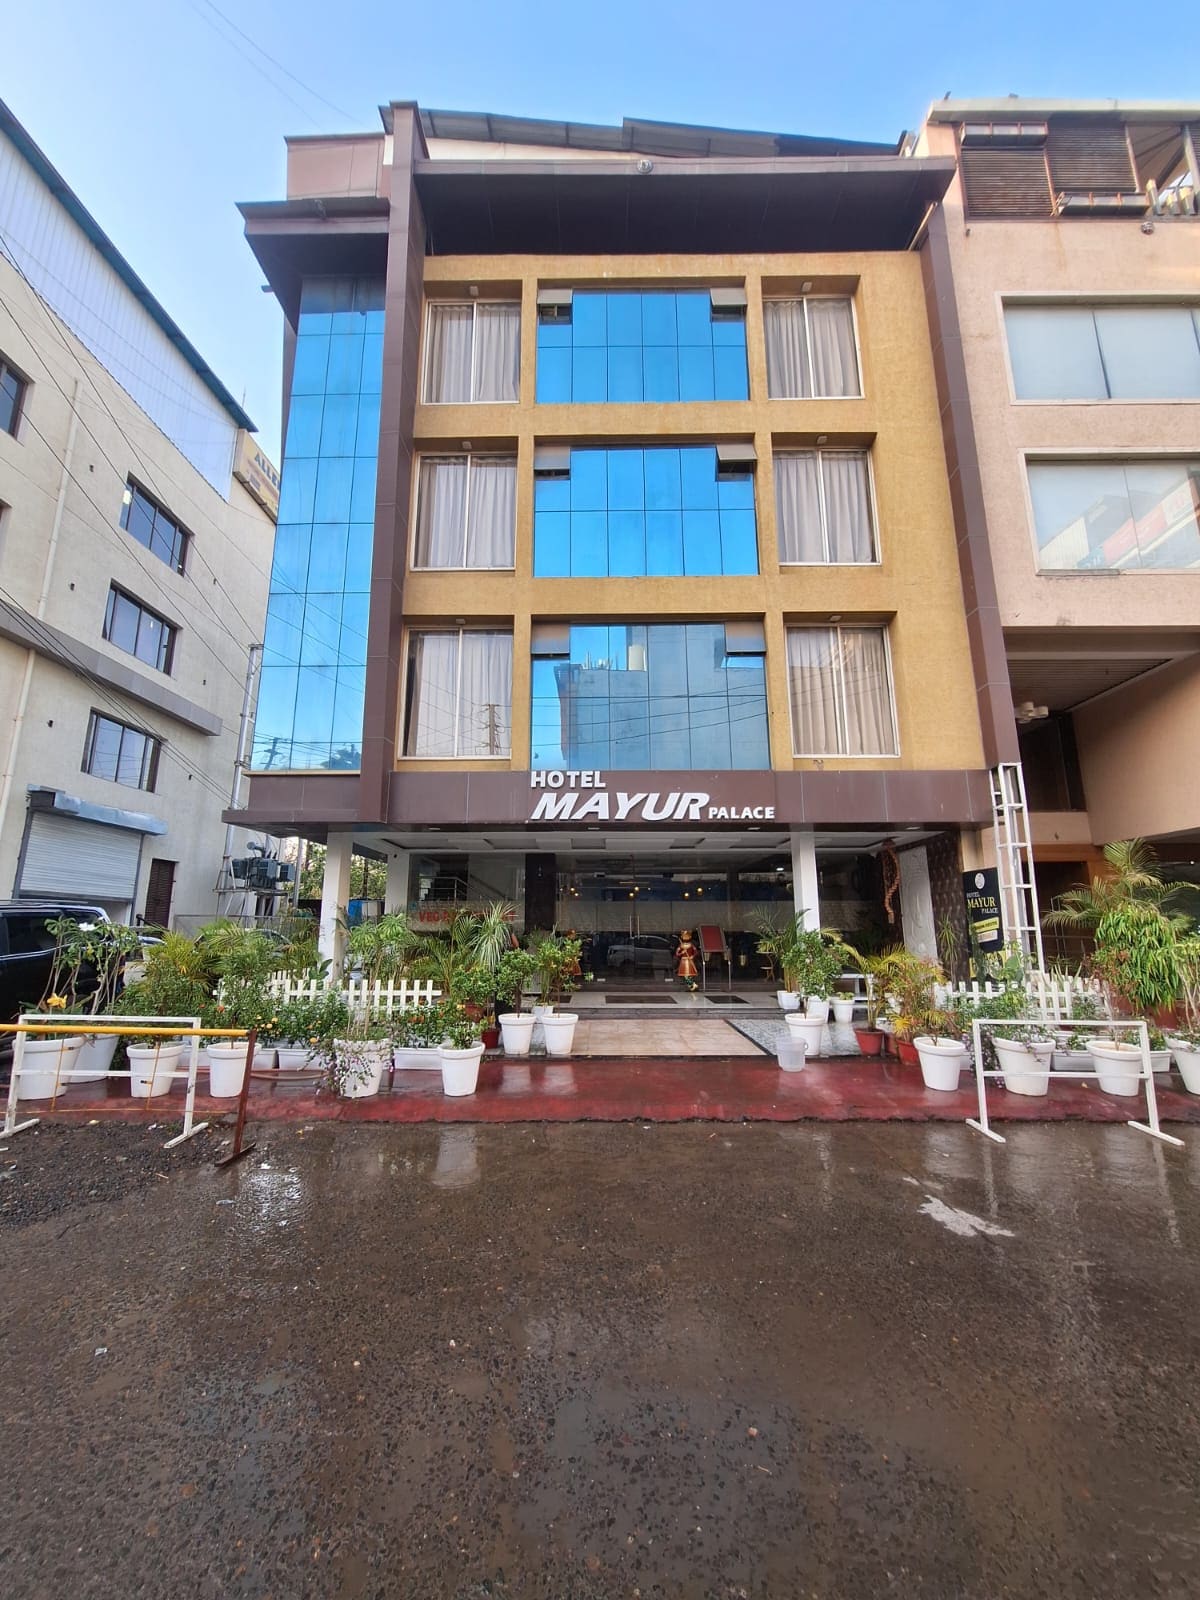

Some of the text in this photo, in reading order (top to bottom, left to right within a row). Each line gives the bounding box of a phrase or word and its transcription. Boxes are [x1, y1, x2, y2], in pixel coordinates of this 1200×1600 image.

[530, 770, 606, 788] HOTEL
[530, 792, 775, 821] MAYUR PALACE
[967, 897, 996, 908] MAYUR
